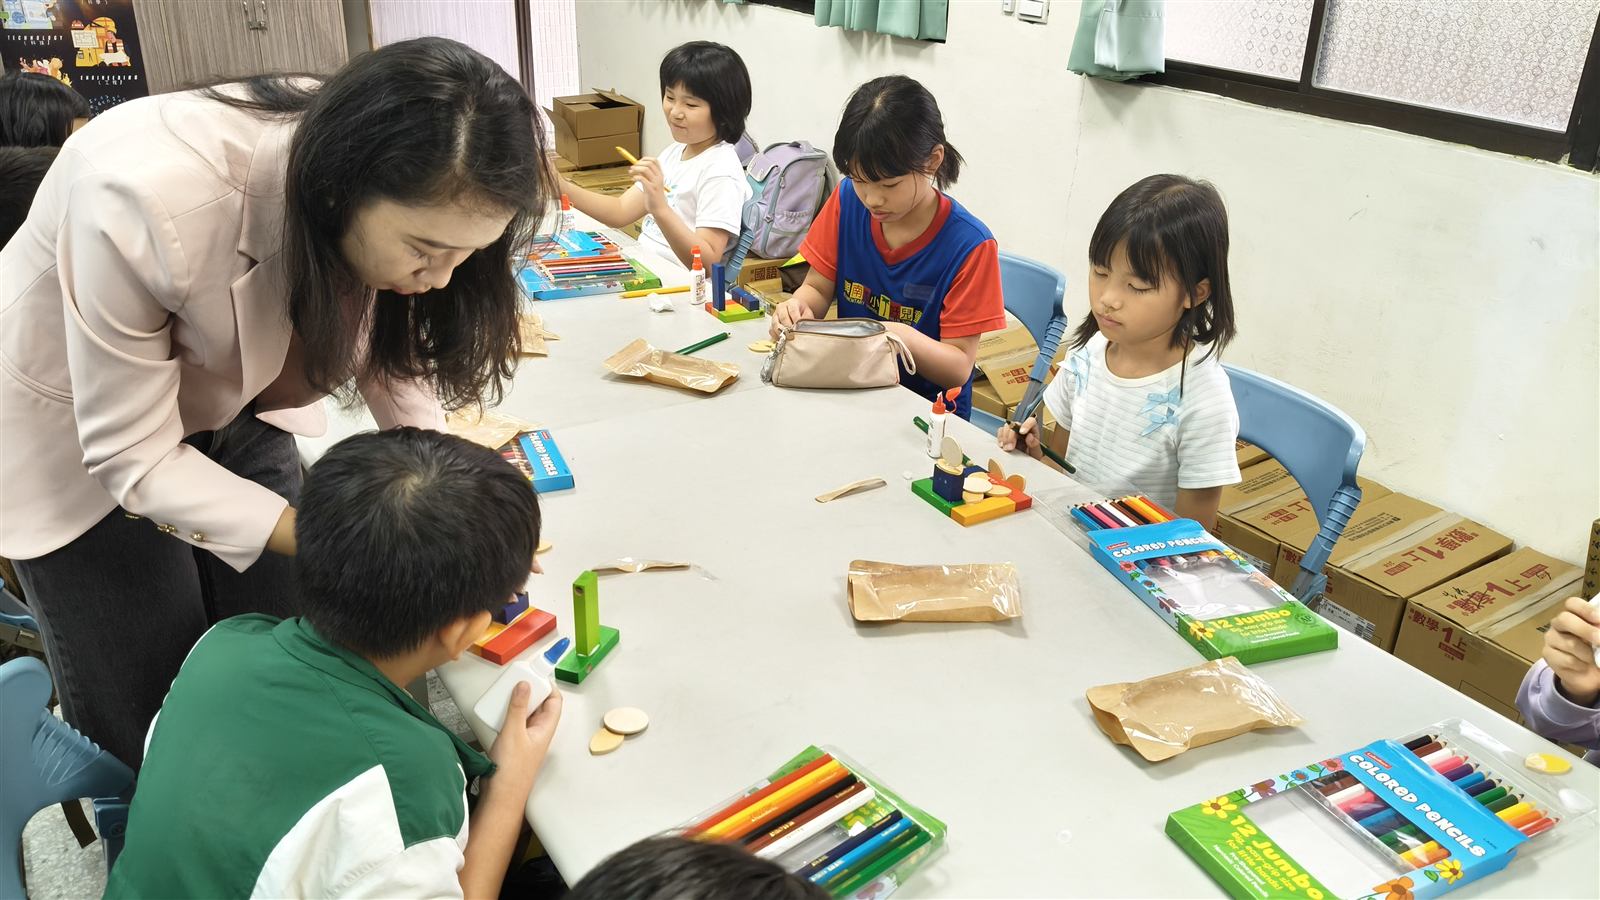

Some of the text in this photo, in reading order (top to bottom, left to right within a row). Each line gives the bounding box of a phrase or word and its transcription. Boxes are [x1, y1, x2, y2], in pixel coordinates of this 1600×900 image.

[1112, 542, 1166, 558] COLORED
[1208, 619, 1233, 629] 12
[1234, 609, 1291, 625] Jumbo
[1349, 755, 1486, 857] COLORED PENCILS
[1230, 815, 1257, 837] 12
[1252, 840, 1324, 900] Jumbo
